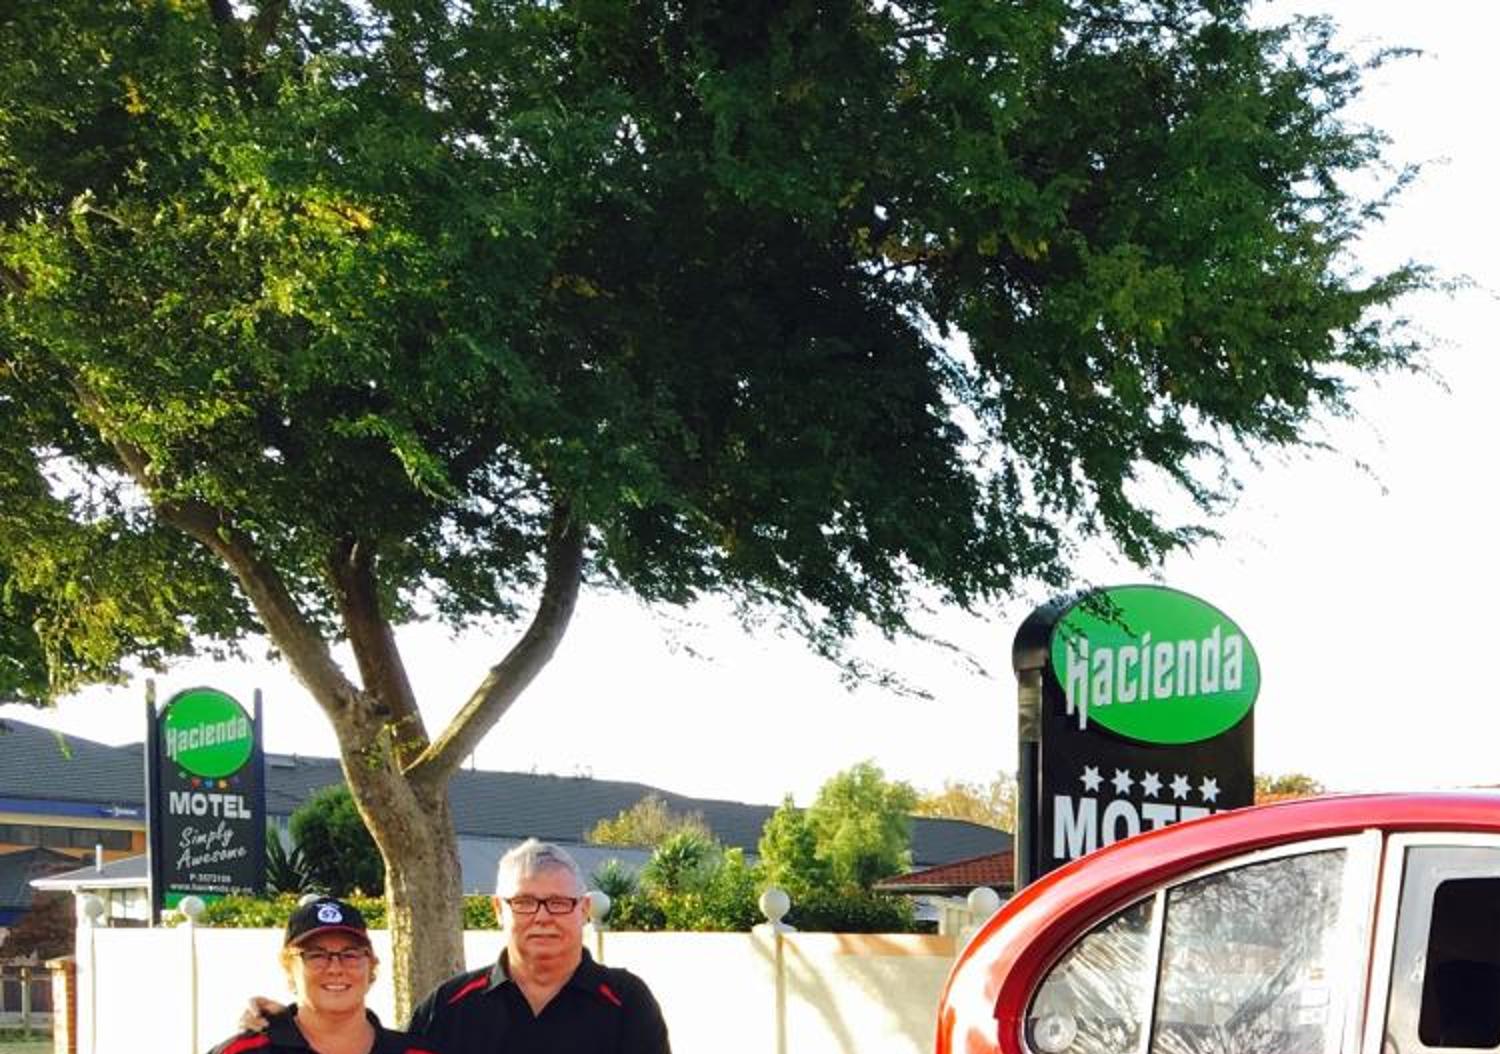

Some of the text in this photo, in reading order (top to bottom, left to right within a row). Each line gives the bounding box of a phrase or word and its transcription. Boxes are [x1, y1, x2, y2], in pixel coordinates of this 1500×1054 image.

[1065, 624, 1244, 730] Hacienda
[165, 714, 248, 762] Hacienda
[169, 791, 251, 819] MOTEL
[179, 820, 234, 849] Simply
[176, 846, 247, 871] Awesome
